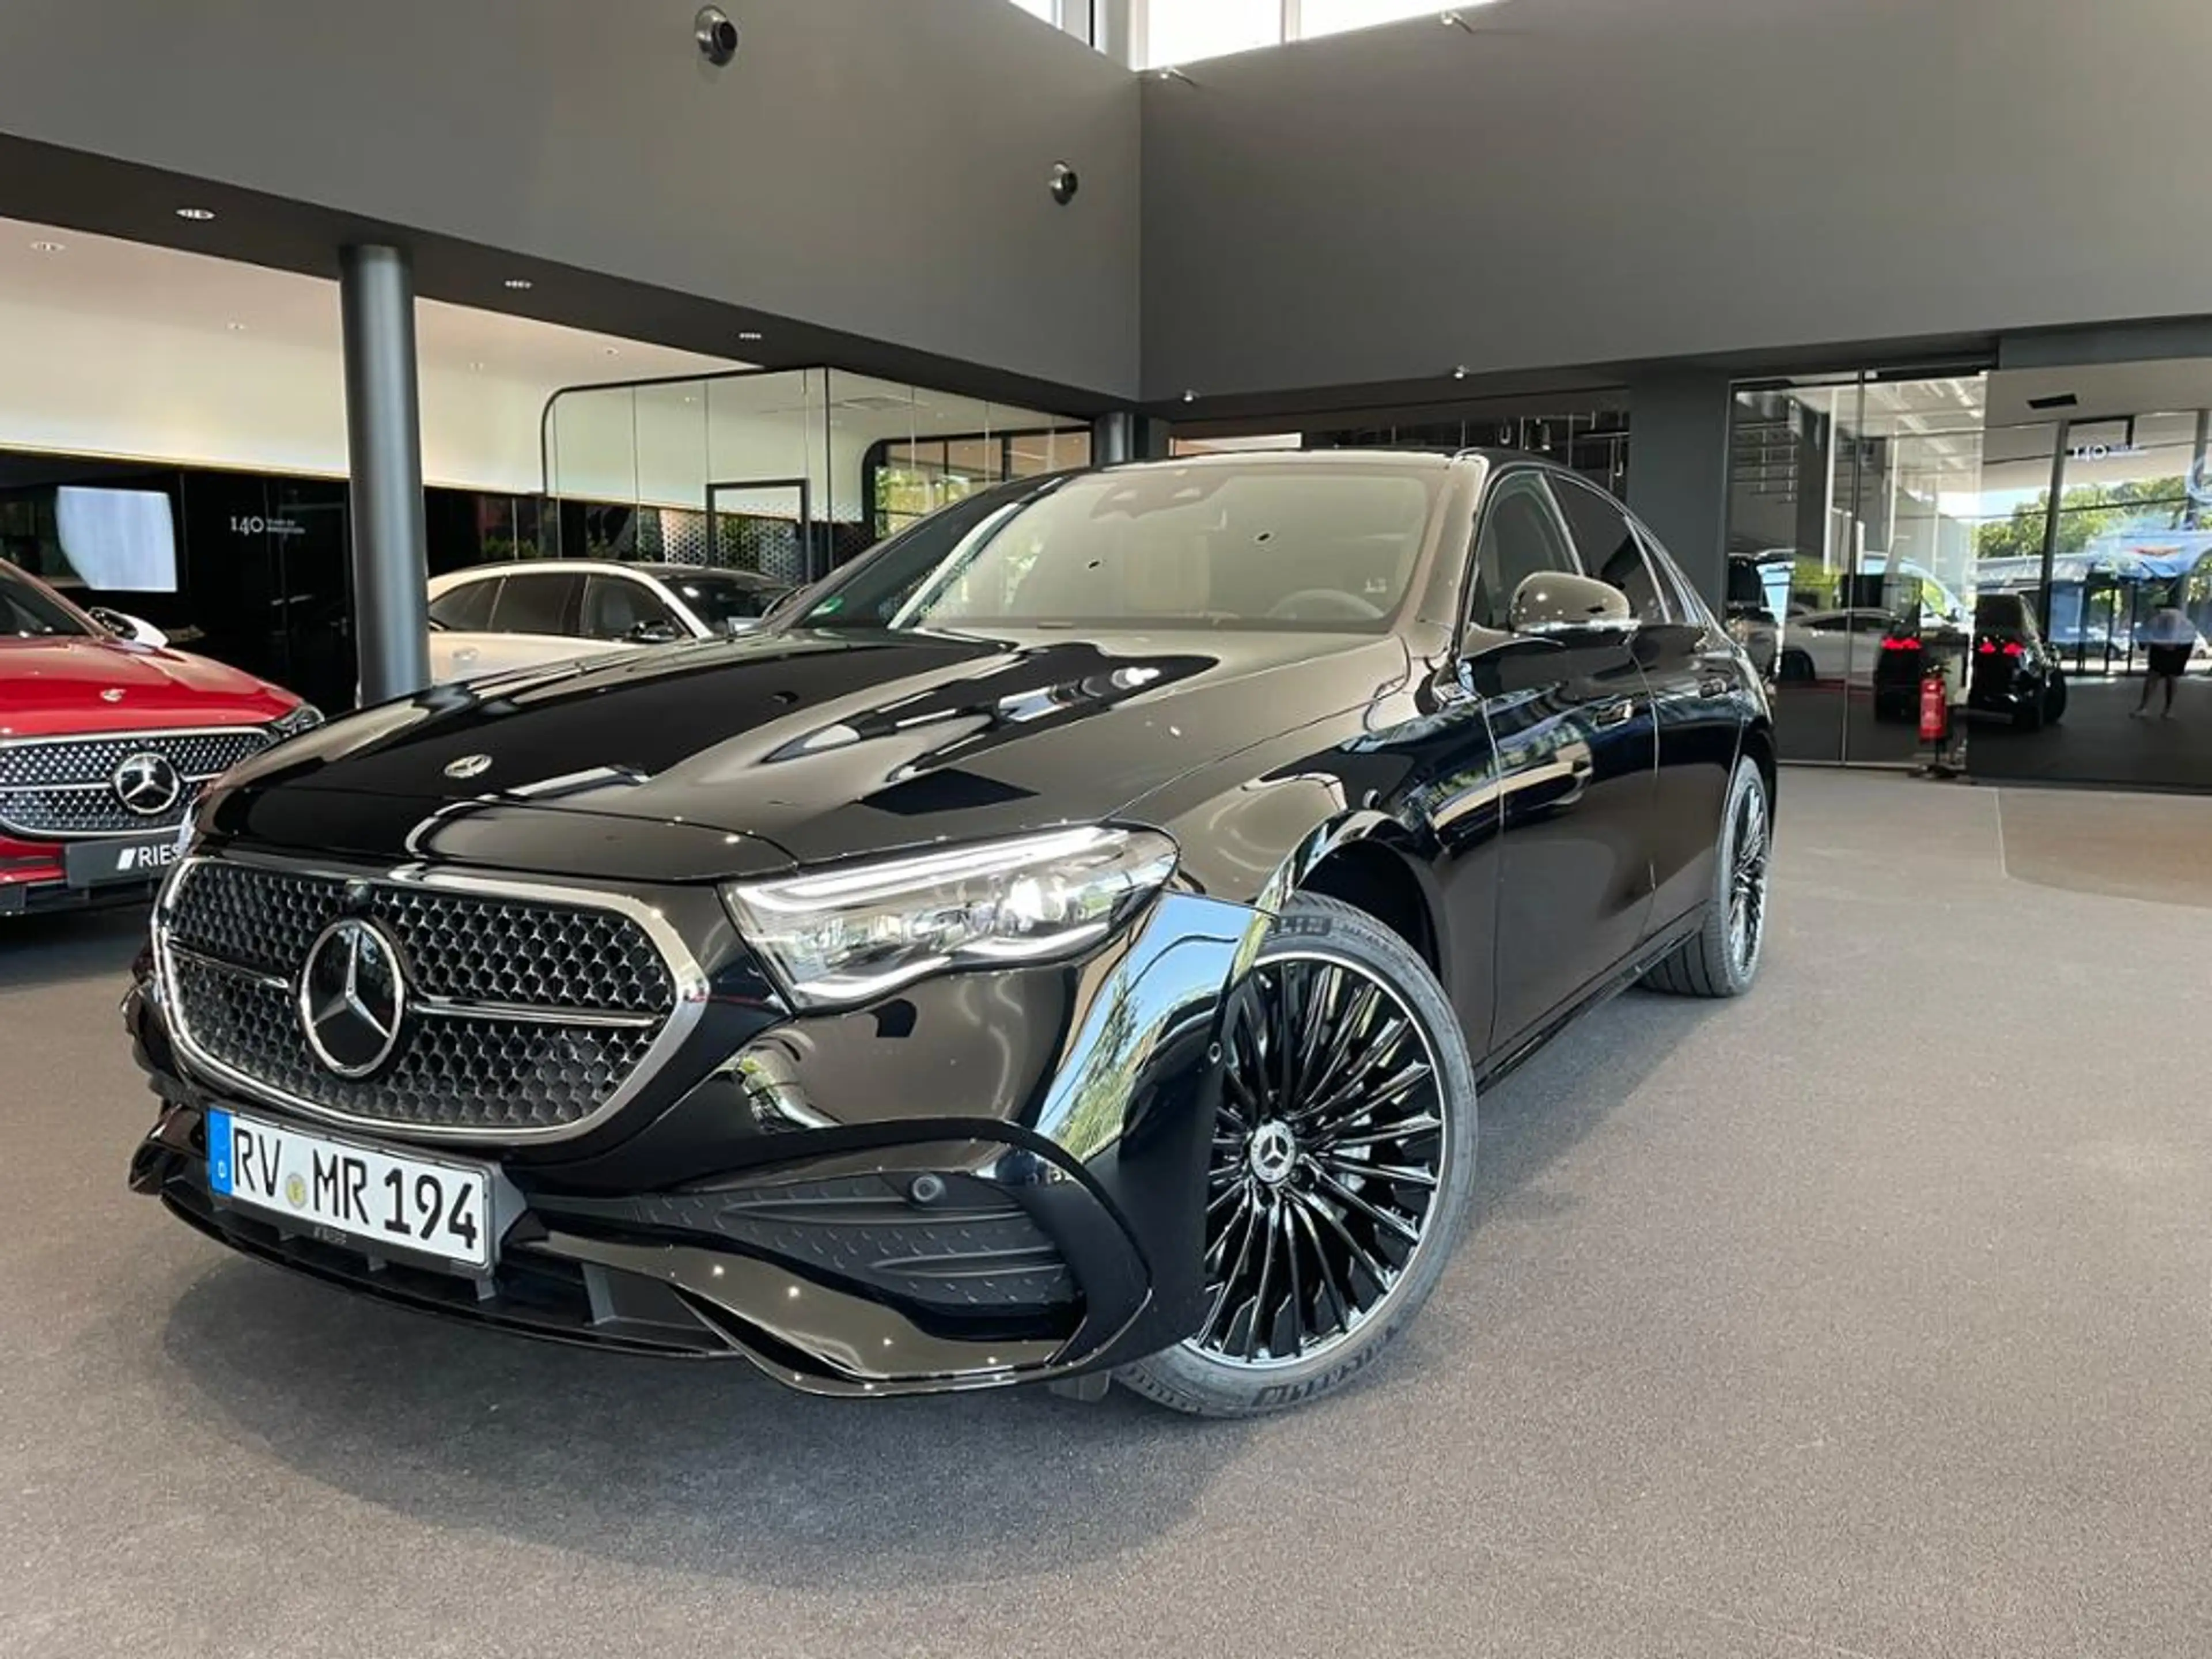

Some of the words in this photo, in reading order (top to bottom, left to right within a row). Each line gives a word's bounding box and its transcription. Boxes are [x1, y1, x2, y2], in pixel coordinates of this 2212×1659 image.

[233, 1128, 281, 1198] RV
[313, 1148, 369, 1225] MR
[384, 1168, 477, 1249] 194
